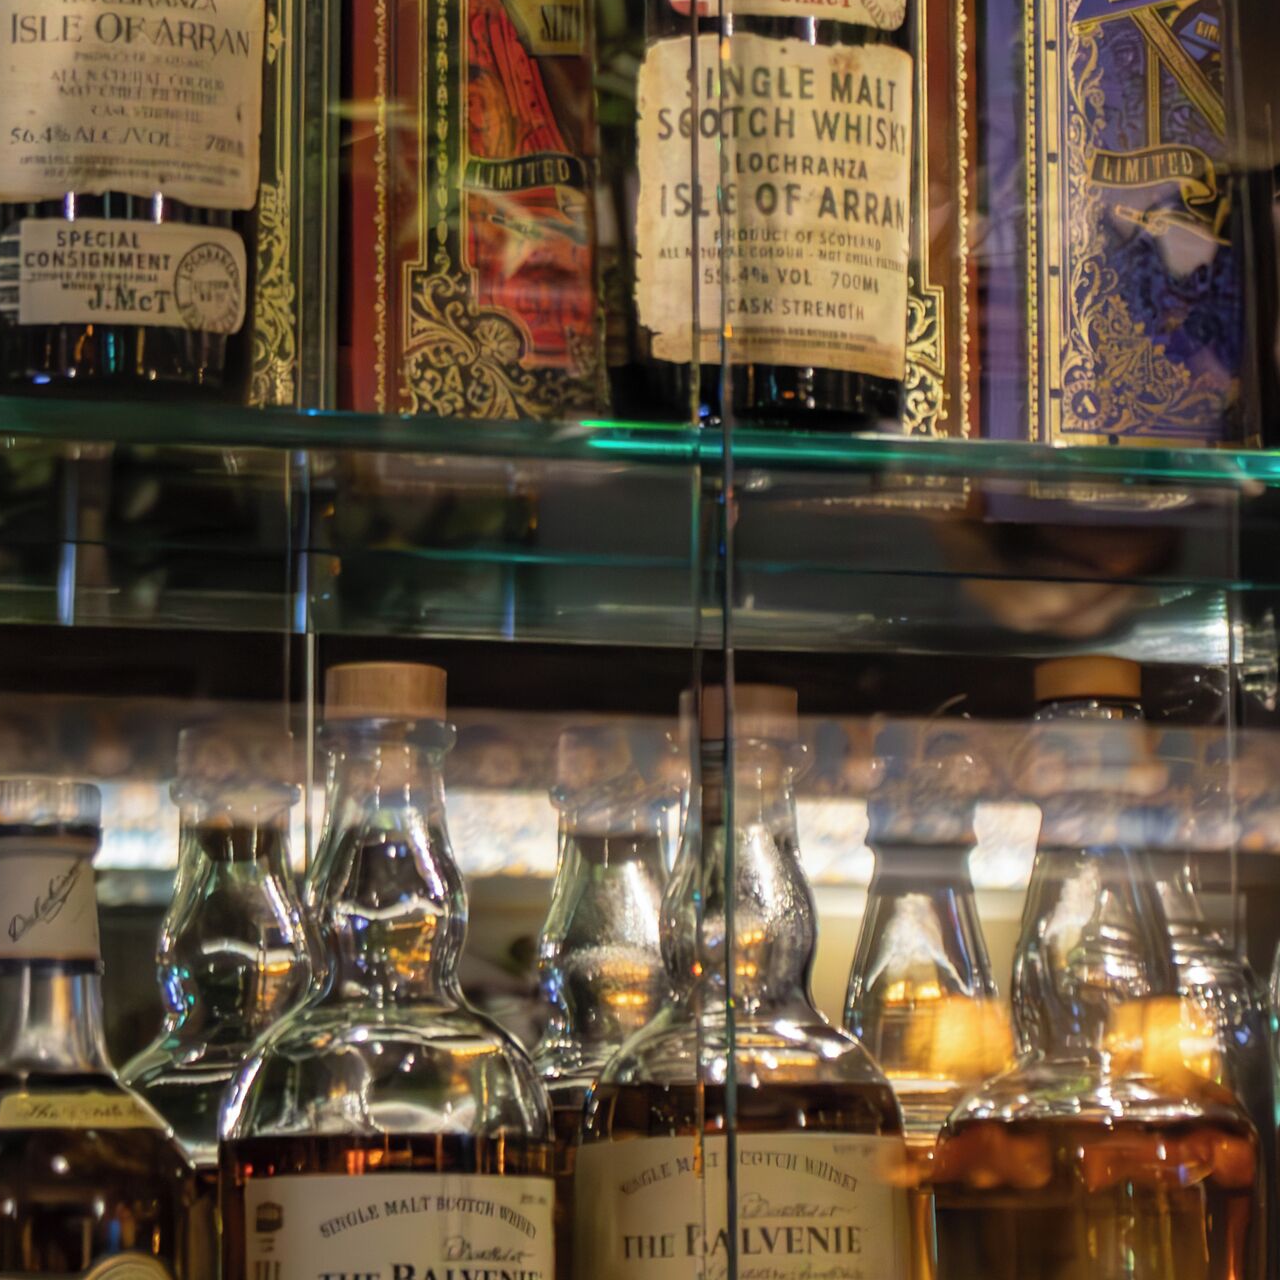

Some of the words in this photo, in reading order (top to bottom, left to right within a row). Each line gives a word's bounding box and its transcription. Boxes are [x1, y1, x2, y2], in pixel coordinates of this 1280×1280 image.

[10, 12, 83, 45] ISLE
[94, 12, 145, 44] OF
[154, 16, 251, 58] ARRAN
[830, 71, 897, 113] MALT
[657, 105, 795, 141] SCOTCH
[474, 158, 570, 190] LIMITED
[735, 152, 868, 181] LOCHRANZA
[1102, 150, 1194, 183] LIMITED
[660, 182, 738, 218] ISLE
[755, 181, 802, 216] OF
[819, 186, 905, 230] ARRAN
[56, 230, 141, 249] SPECIAL
[795, 229, 813, 244] OF
[23, 250, 172, 271] CONSIGNMENT
[776, 269, 813, 287] VOL
[86, 285, 173, 314] J.McT
[727, 298, 774, 315] CASK
[781, 299, 866, 321] STRENGTH
[739, 1149, 797, 1171] COTCH
[384, 1195, 432, 1217] MALT
[623, 1234, 675, 1259] THE
[685, 1222, 863, 1257] BALVENIE
